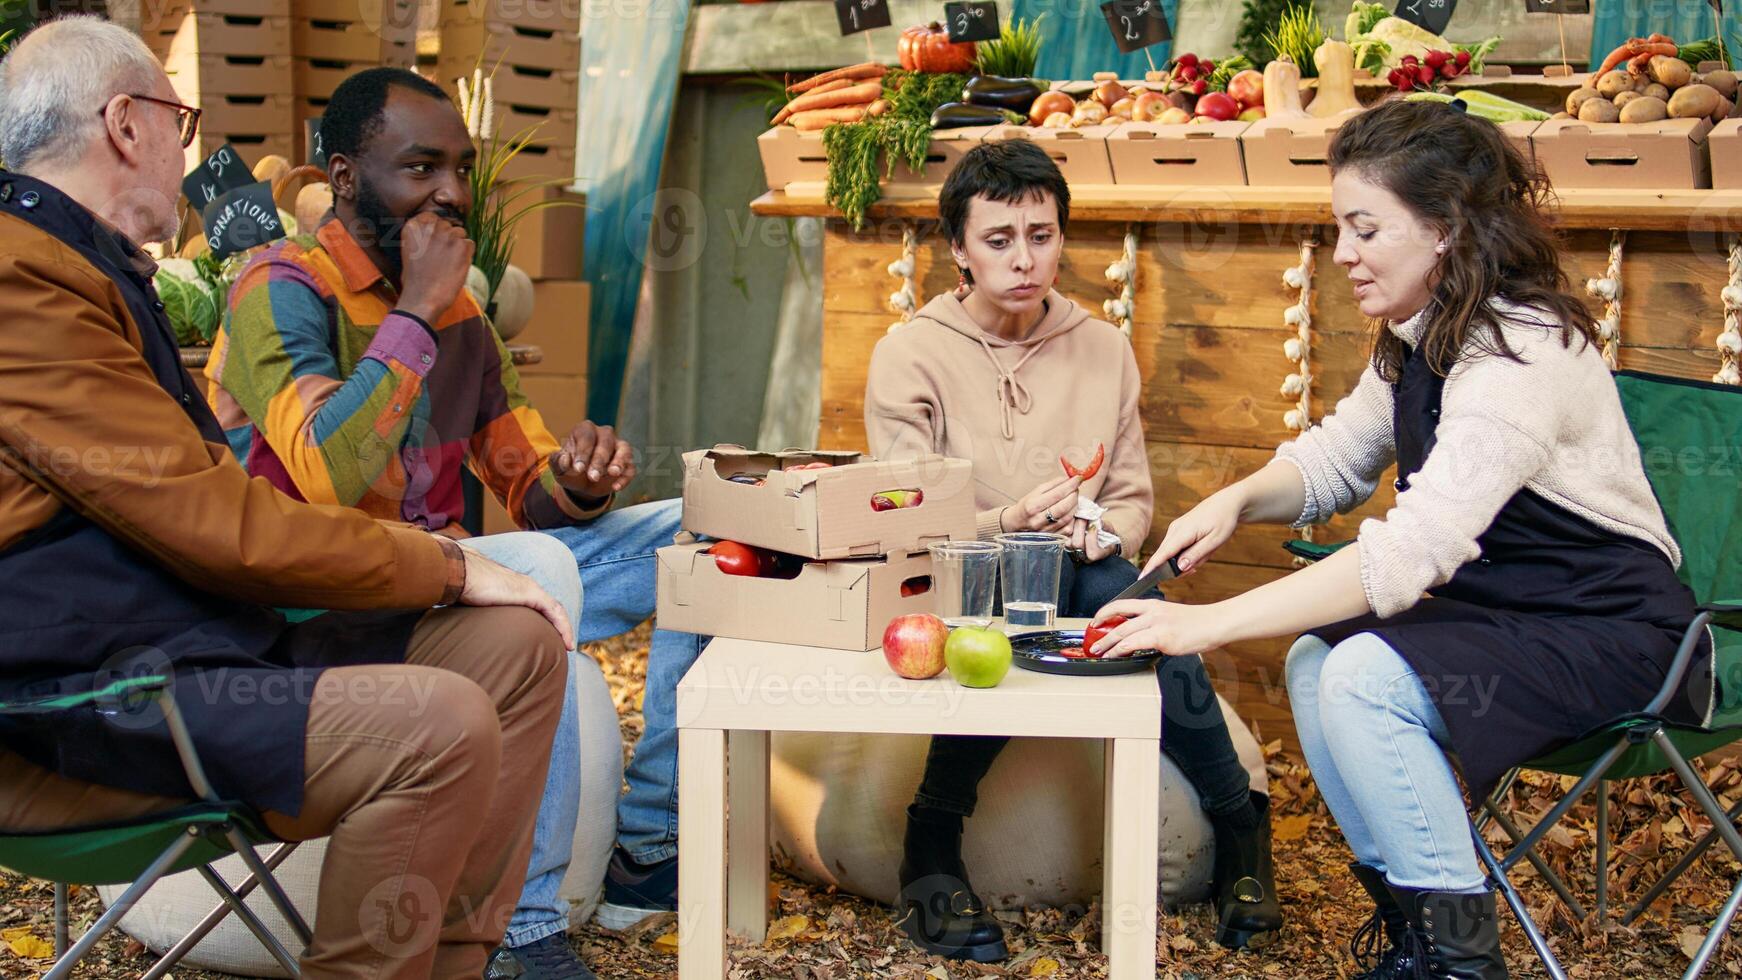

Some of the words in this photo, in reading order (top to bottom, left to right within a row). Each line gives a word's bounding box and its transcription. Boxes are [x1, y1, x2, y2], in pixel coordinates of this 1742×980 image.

[956, 12, 974, 35] 3
[1121, 15, 1139, 41] 2
[208, 196, 278, 250] DONATIONS
